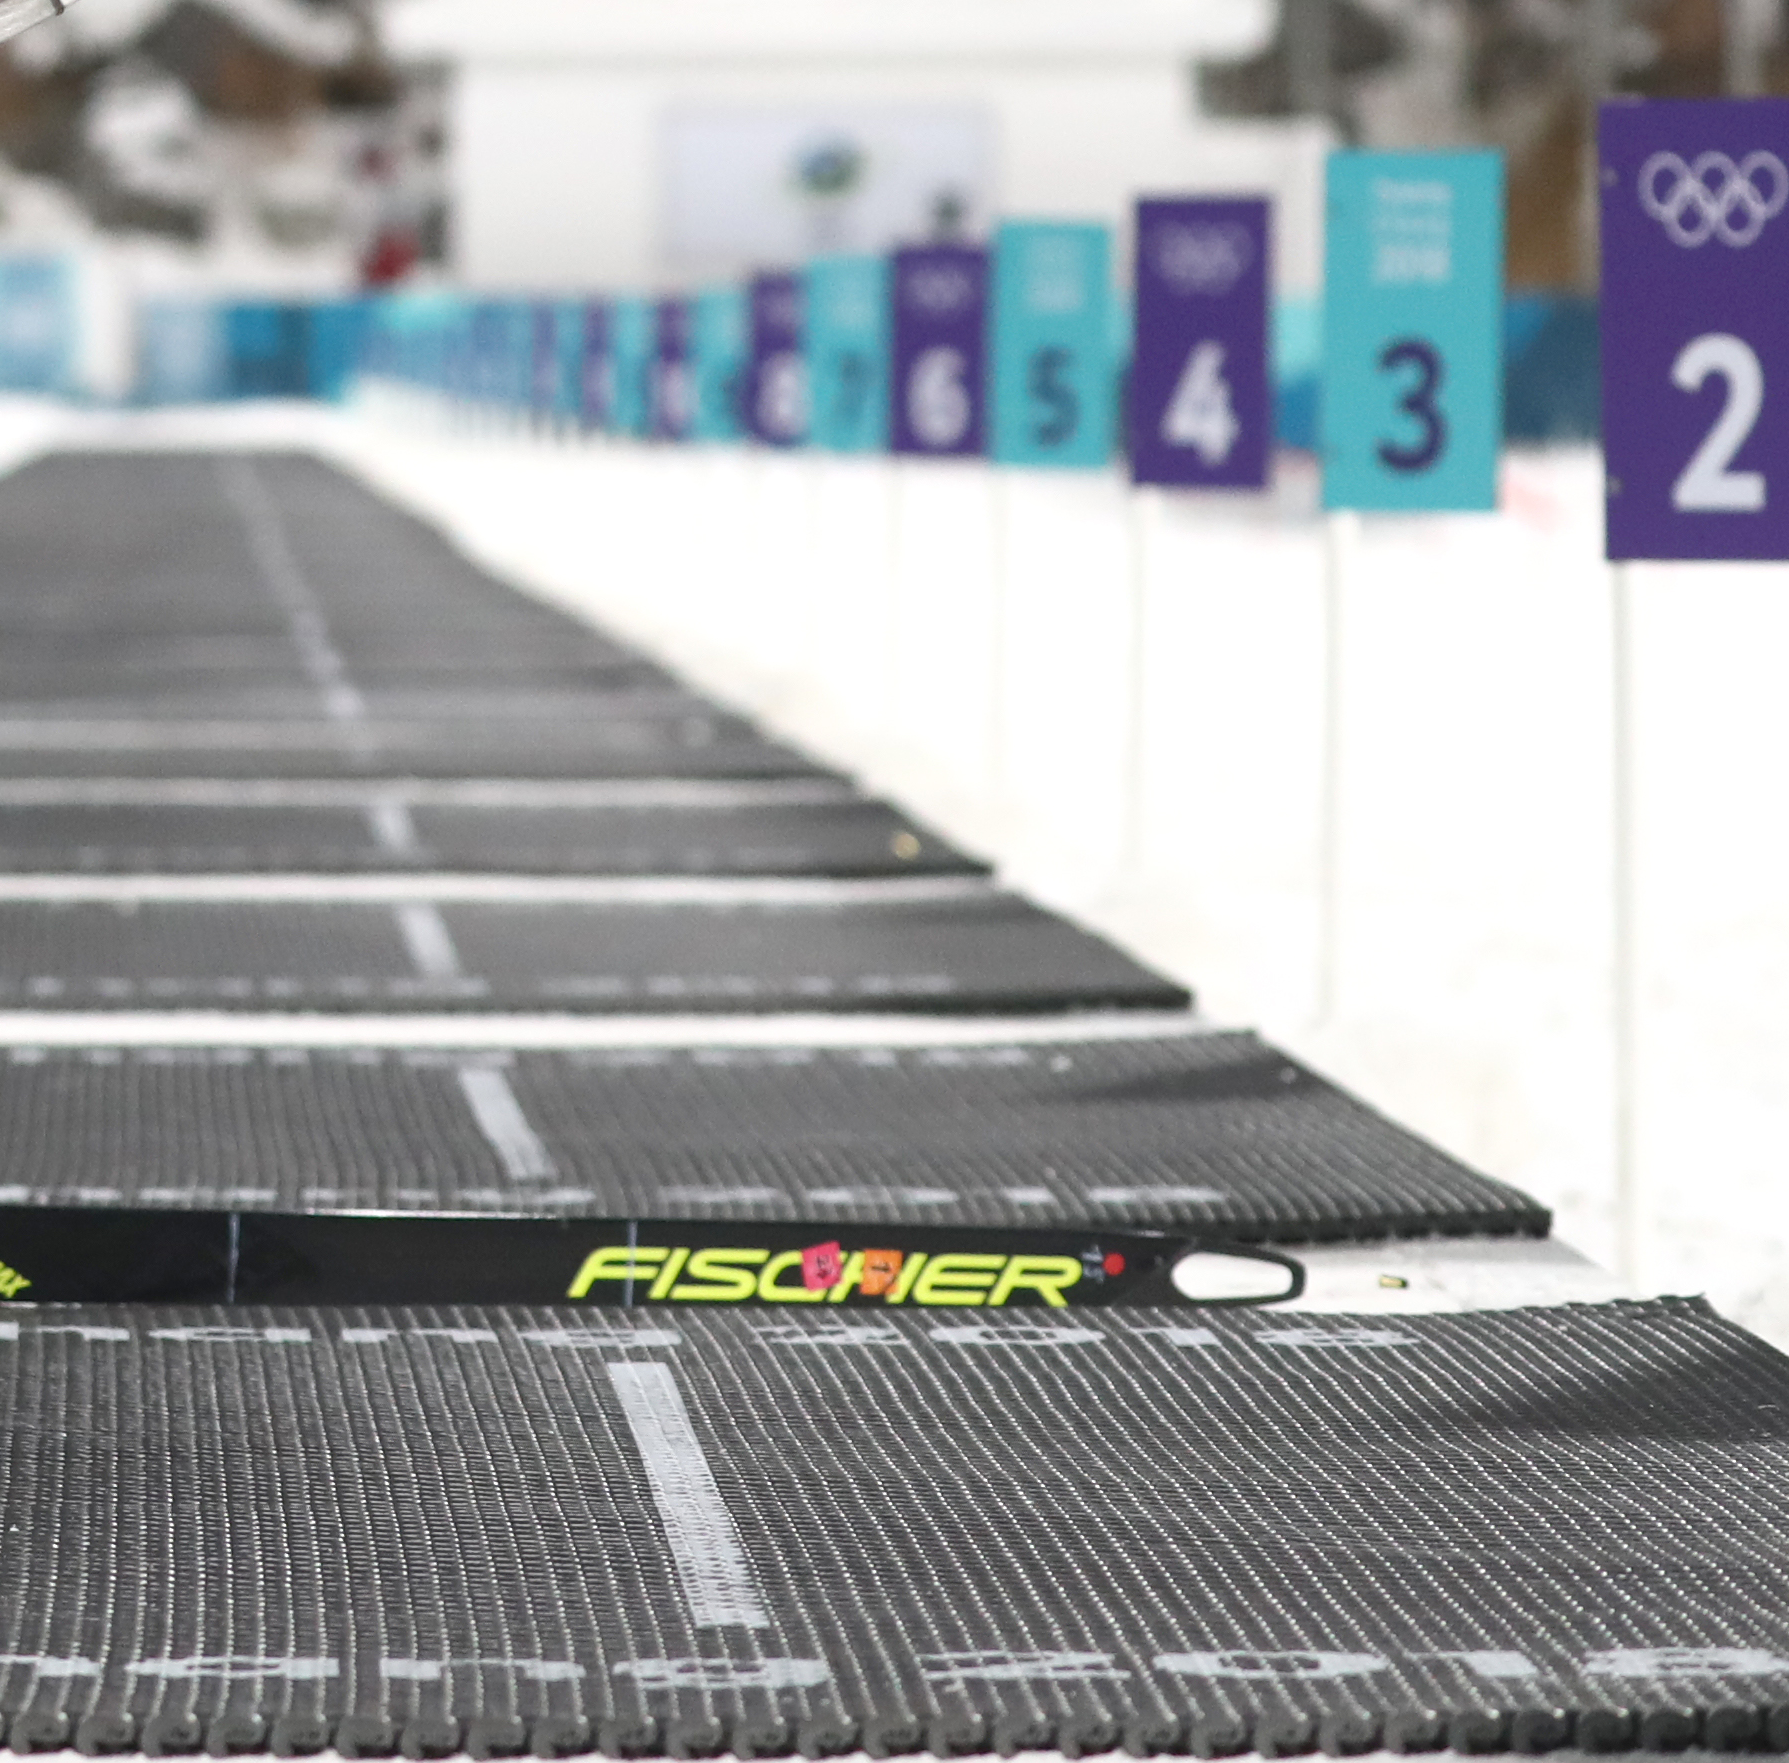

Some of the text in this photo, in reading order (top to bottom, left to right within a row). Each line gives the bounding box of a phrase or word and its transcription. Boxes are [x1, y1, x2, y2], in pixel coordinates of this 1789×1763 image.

[906, 345, 971, 448] 6
[1029, 345, 1078, 451] 5
[1160, 339, 1241, 468] 4
[1375, 333, 1449, 476] 3
[1670, 331, 1766, 512] 2
[567, 1246, 1083, 1307] FISCHER
